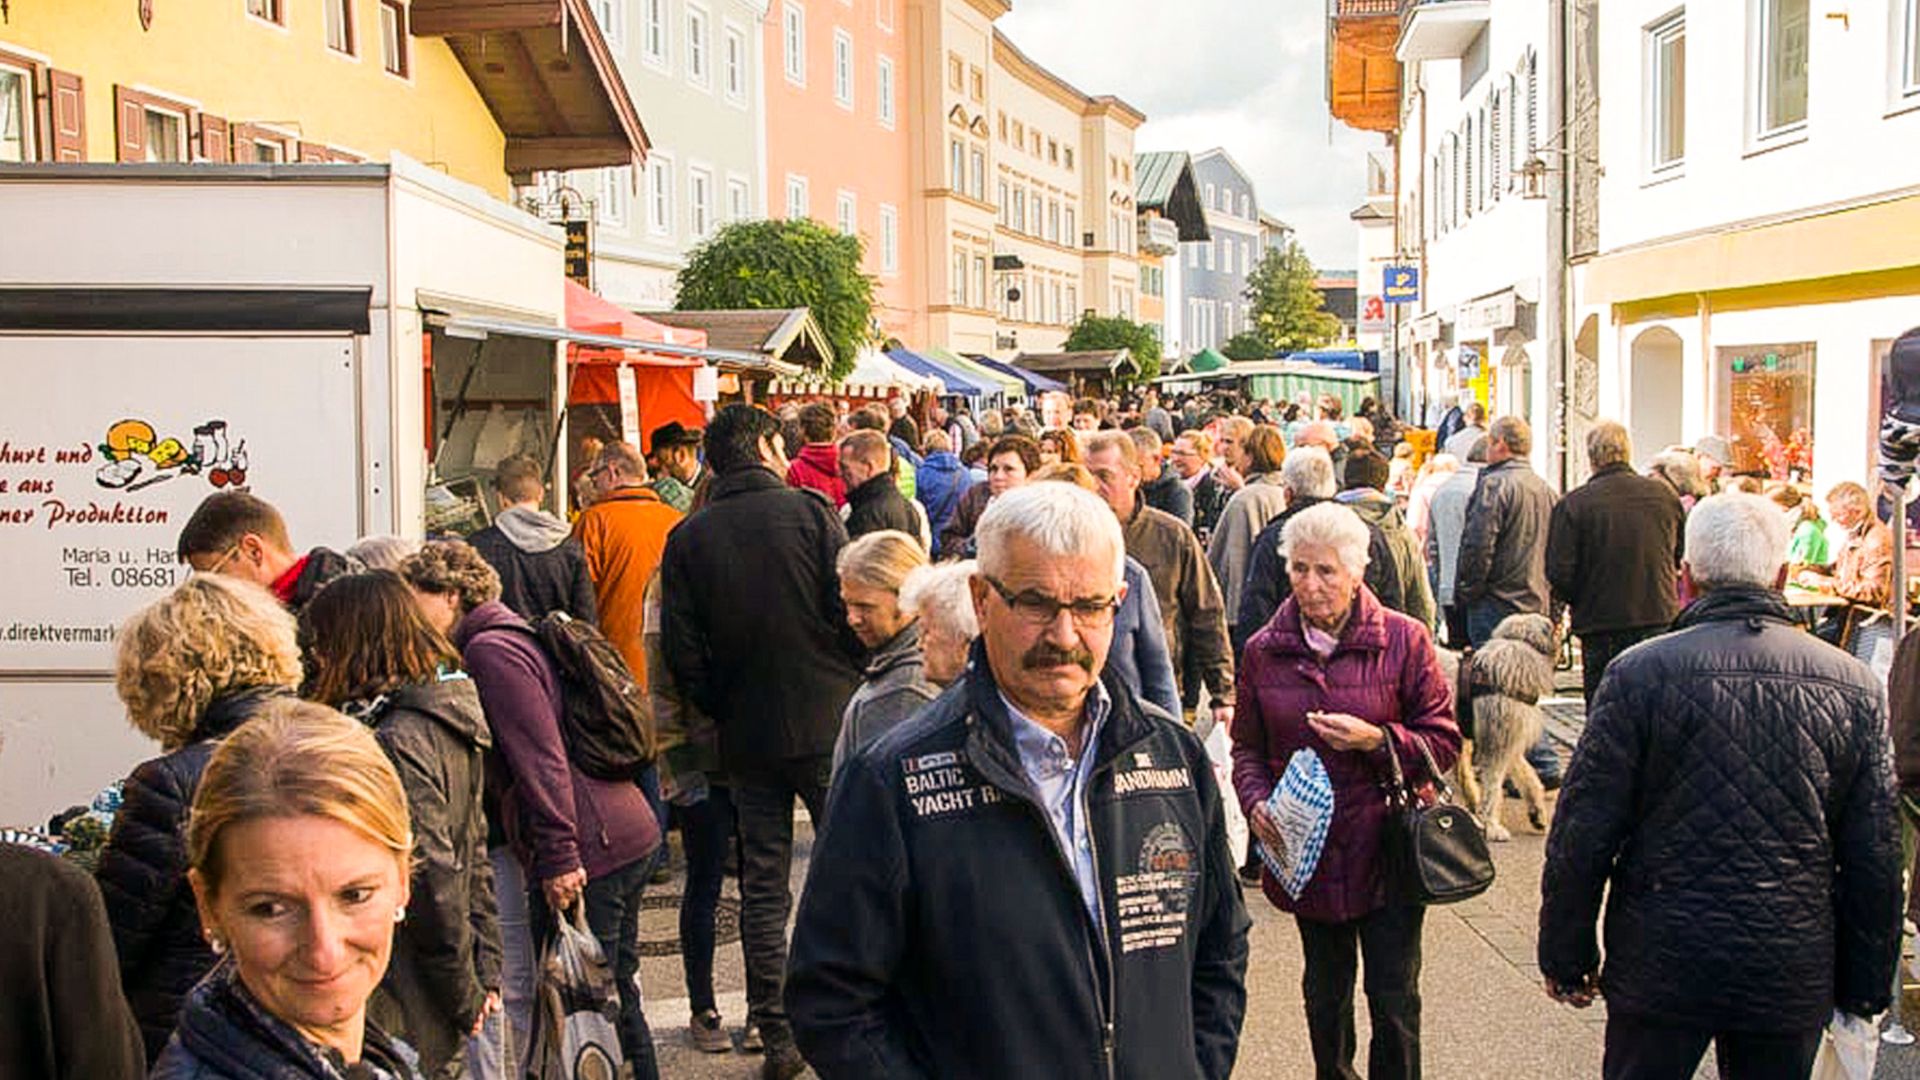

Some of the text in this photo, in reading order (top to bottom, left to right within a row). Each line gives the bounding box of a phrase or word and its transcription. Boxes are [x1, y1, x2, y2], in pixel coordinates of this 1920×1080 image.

[55, 443, 93, 464] und
[18, 479, 54, 493] aus
[42, 500, 168, 529] Produktion
[63, 548, 110, 563] Maria
[64, 567, 175, 587] Tel. 08681
[905, 767, 965, 794] BALTIC
[912, 788, 975, 815] YACHT
